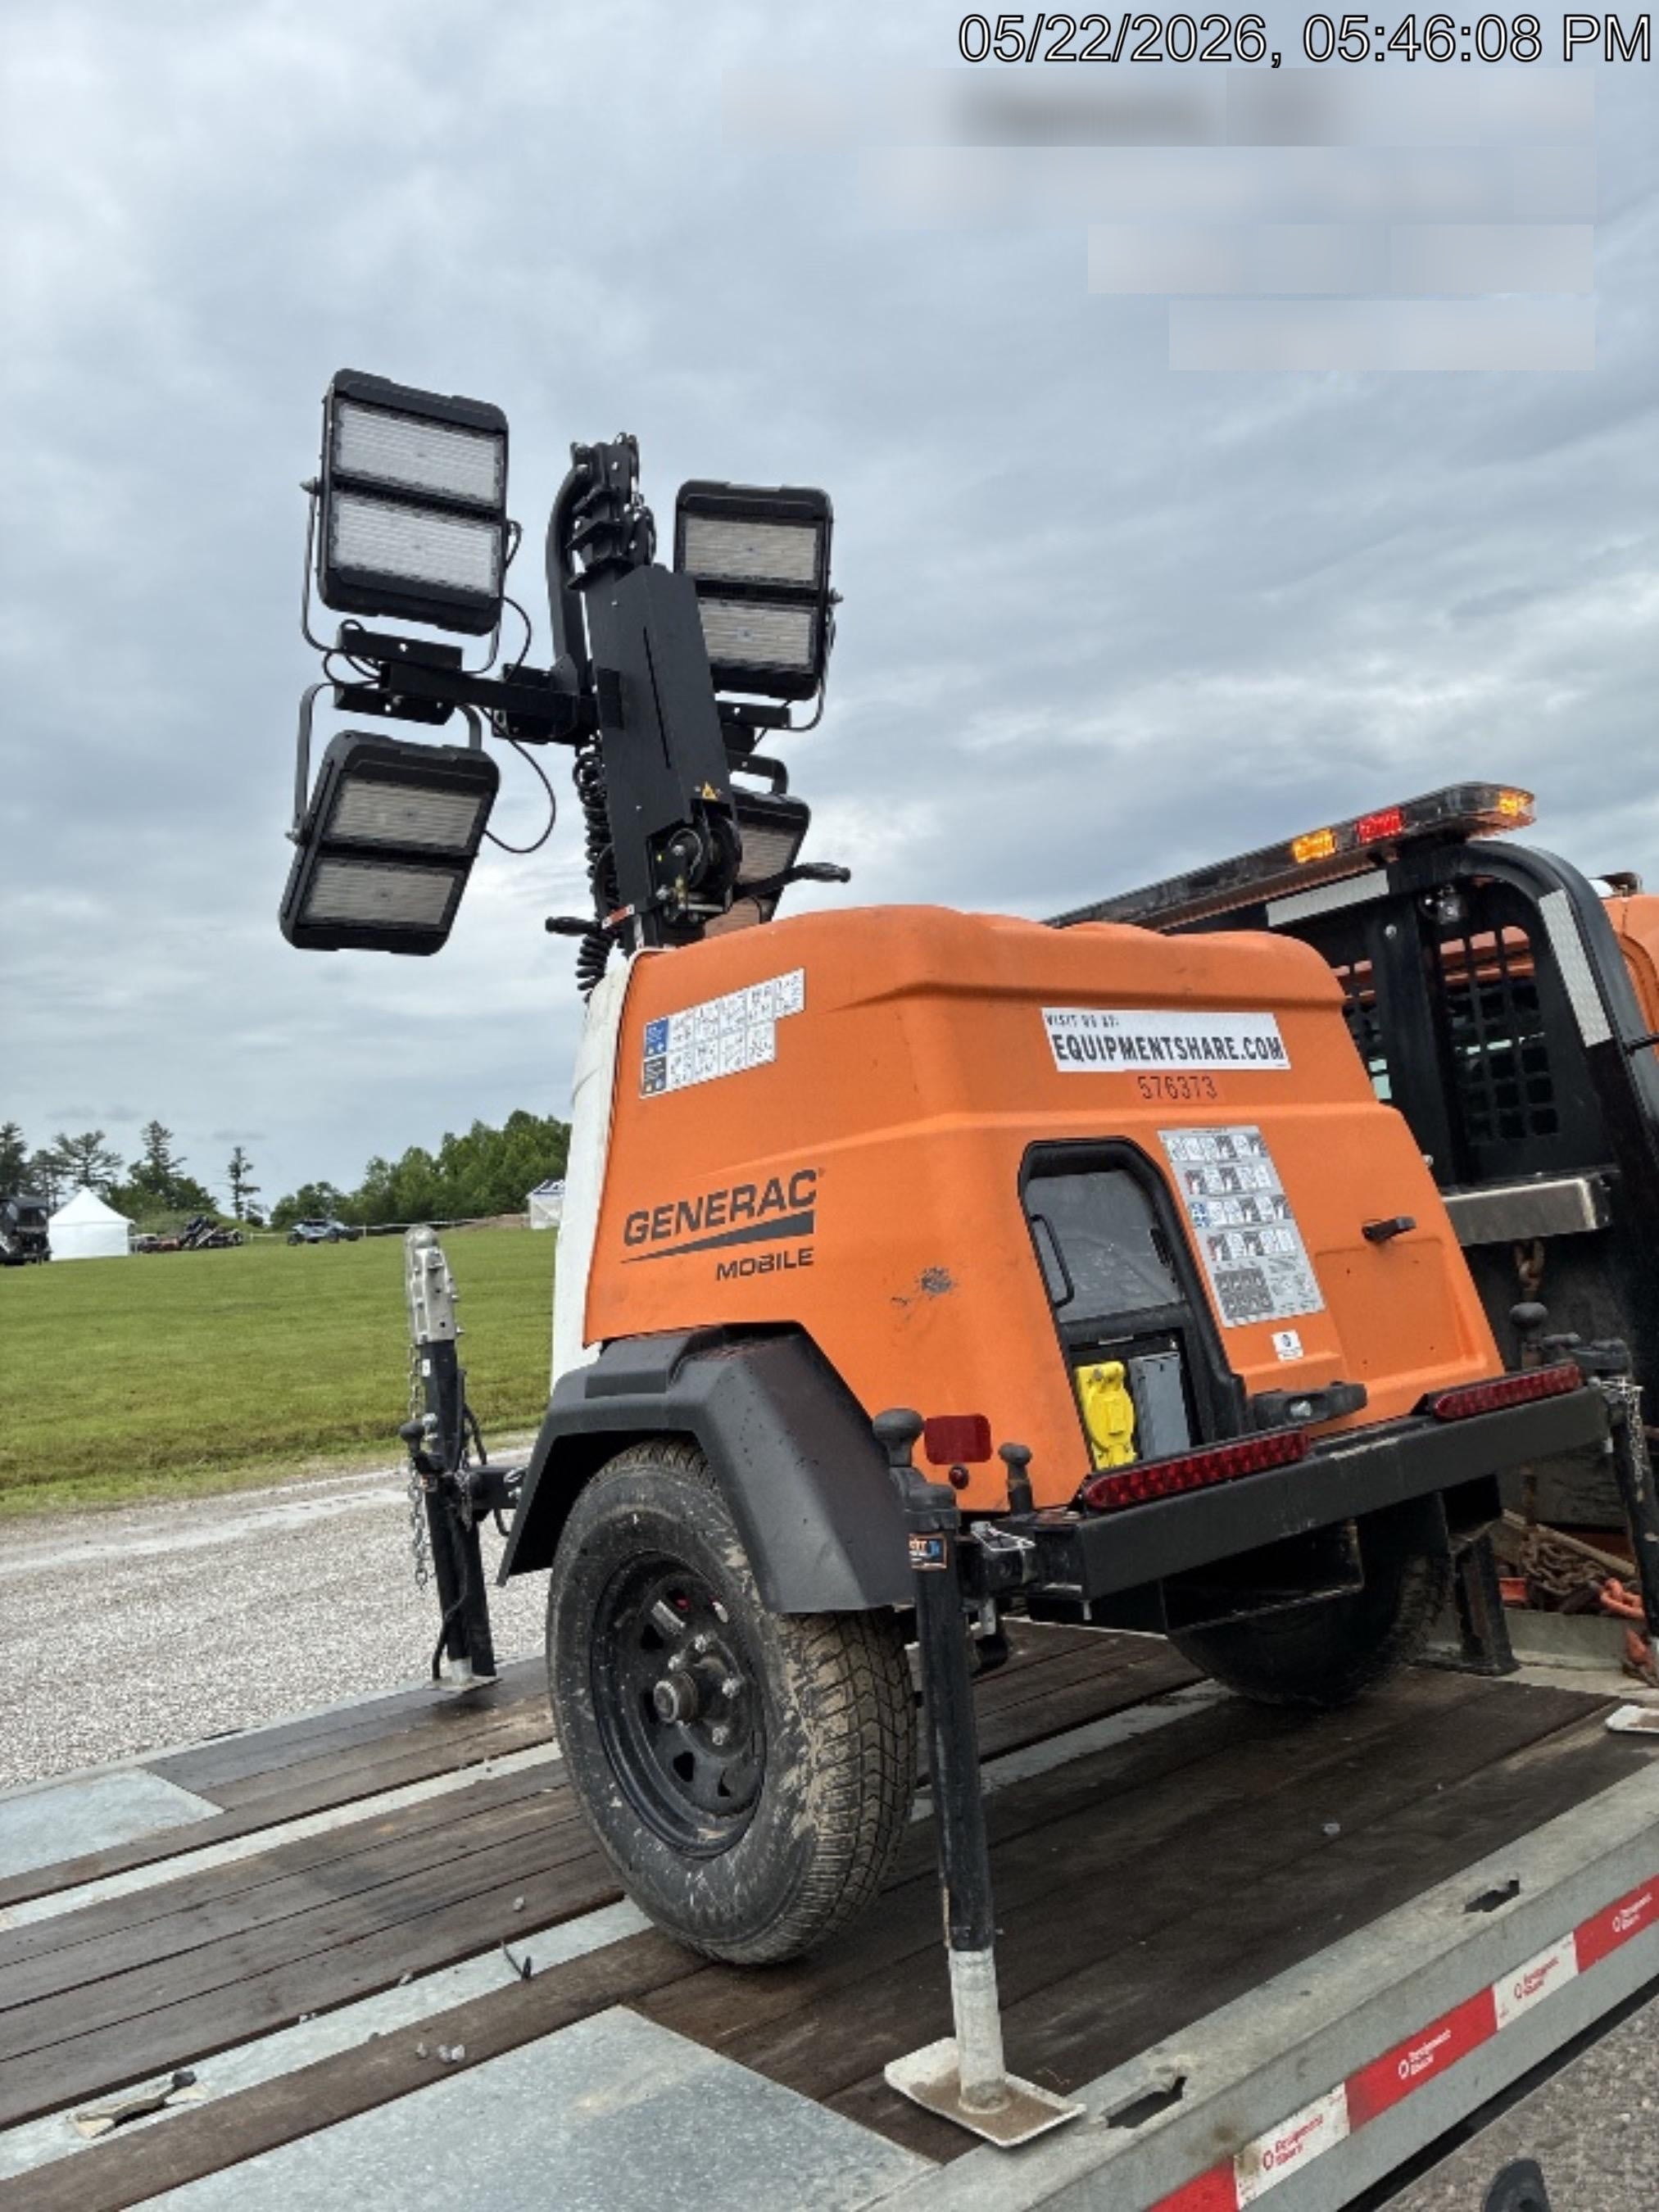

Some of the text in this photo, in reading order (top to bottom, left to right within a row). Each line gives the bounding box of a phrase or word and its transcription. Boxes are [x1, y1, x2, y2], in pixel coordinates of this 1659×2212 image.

[1052, 1034, 1285, 1062] EQUIPMENTSHARE.COM
[1137, 1076, 1218, 1099] 576373
[623, 1169, 818, 1247] GENERAC
[716, 1248, 814, 1281] MOBILE
